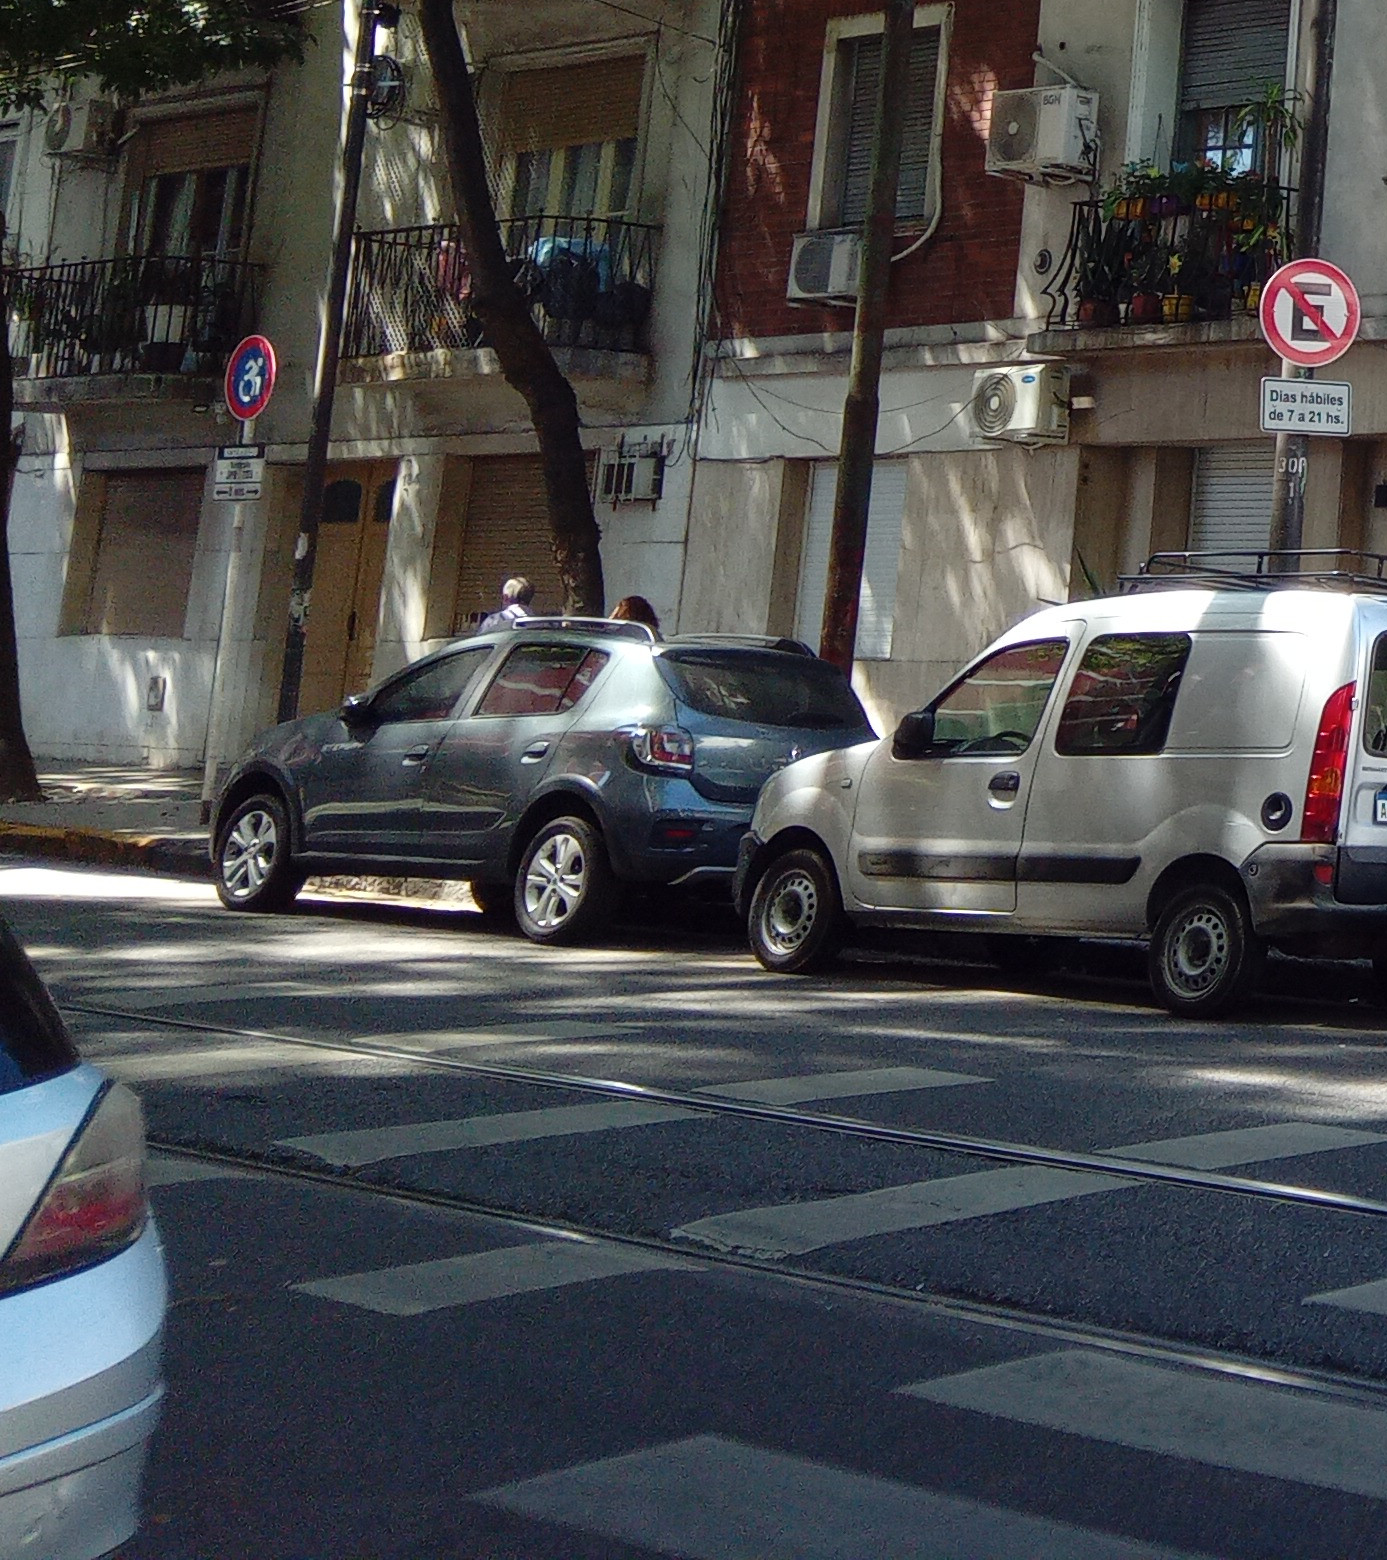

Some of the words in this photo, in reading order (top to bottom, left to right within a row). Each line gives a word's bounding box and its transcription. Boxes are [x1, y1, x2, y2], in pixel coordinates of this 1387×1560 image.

[1300, 391, 1344, 406] hábiles
[1268, 409, 1284, 421] de
[1287, 409, 1295, 422] 7
[1298, 412, 1305, 422] a
[1308, 410, 1322, 423] 21
[1326, 411, 1344, 424] hs.
